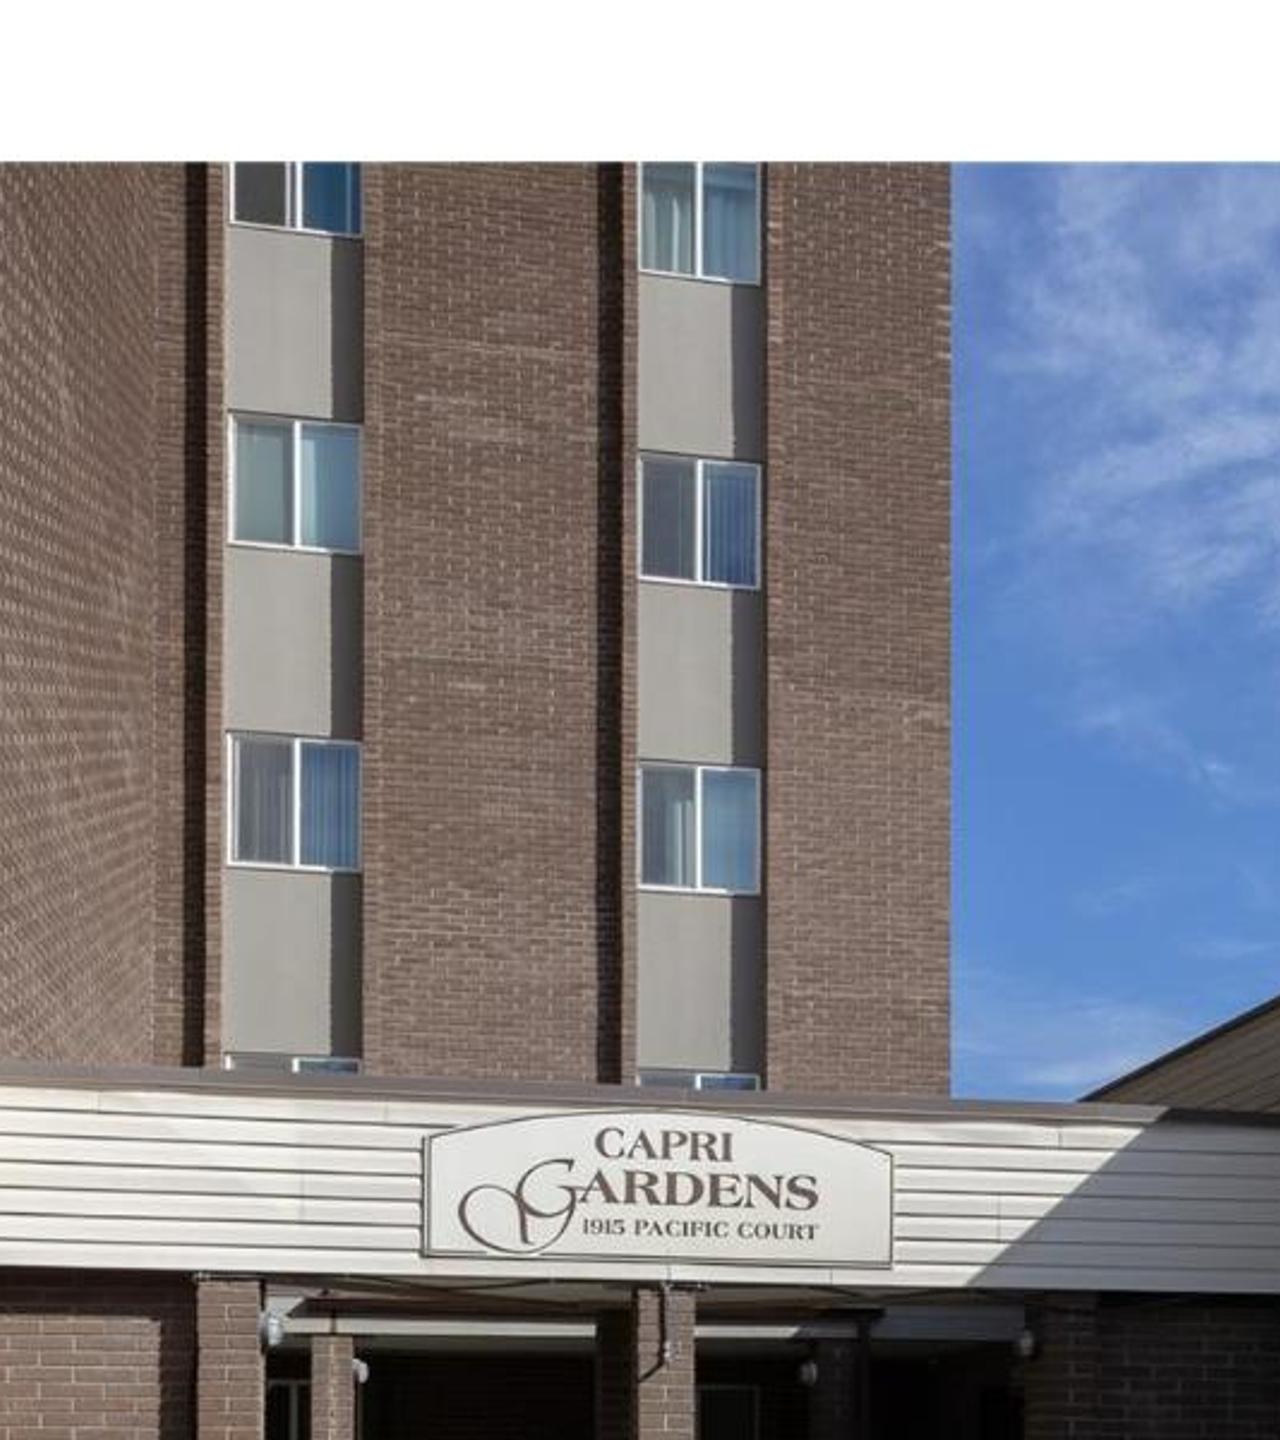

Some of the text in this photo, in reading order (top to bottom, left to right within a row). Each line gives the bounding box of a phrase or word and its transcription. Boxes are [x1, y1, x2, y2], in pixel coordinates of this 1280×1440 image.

[595, 1126, 734, 1163] CAPRI
[458, 1158, 820, 1255] GARDENS
[582, 1219, 821, 1242] 1915 PACIFIC COURT
